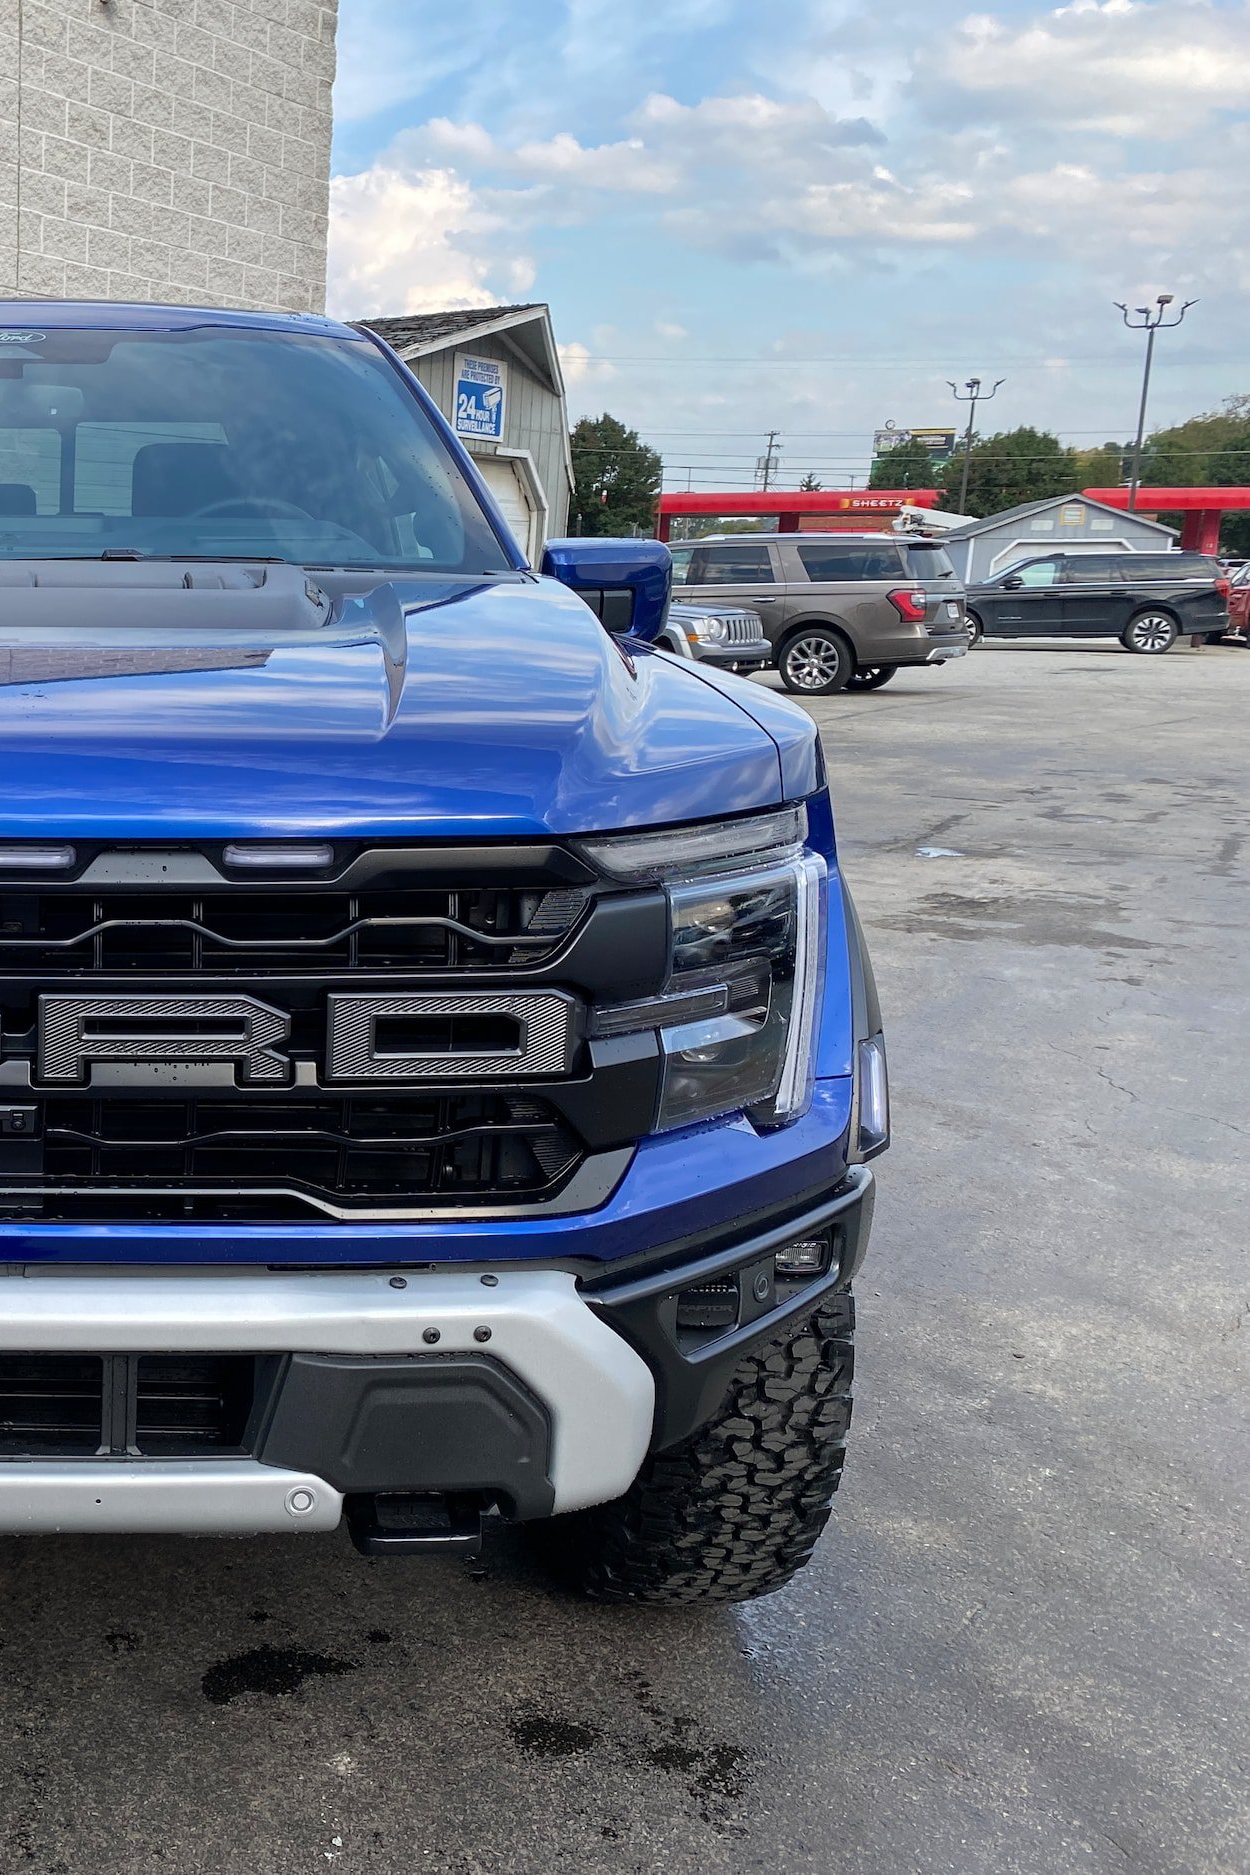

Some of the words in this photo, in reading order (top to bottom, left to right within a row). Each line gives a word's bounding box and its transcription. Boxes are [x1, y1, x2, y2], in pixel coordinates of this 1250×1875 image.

[458, 393, 477, 420] 24
[475, 409, 491, 422] HOUR
[457, 418, 496, 434] SURVEILLANCE
[852, 498, 904, 507] SHEETZ
